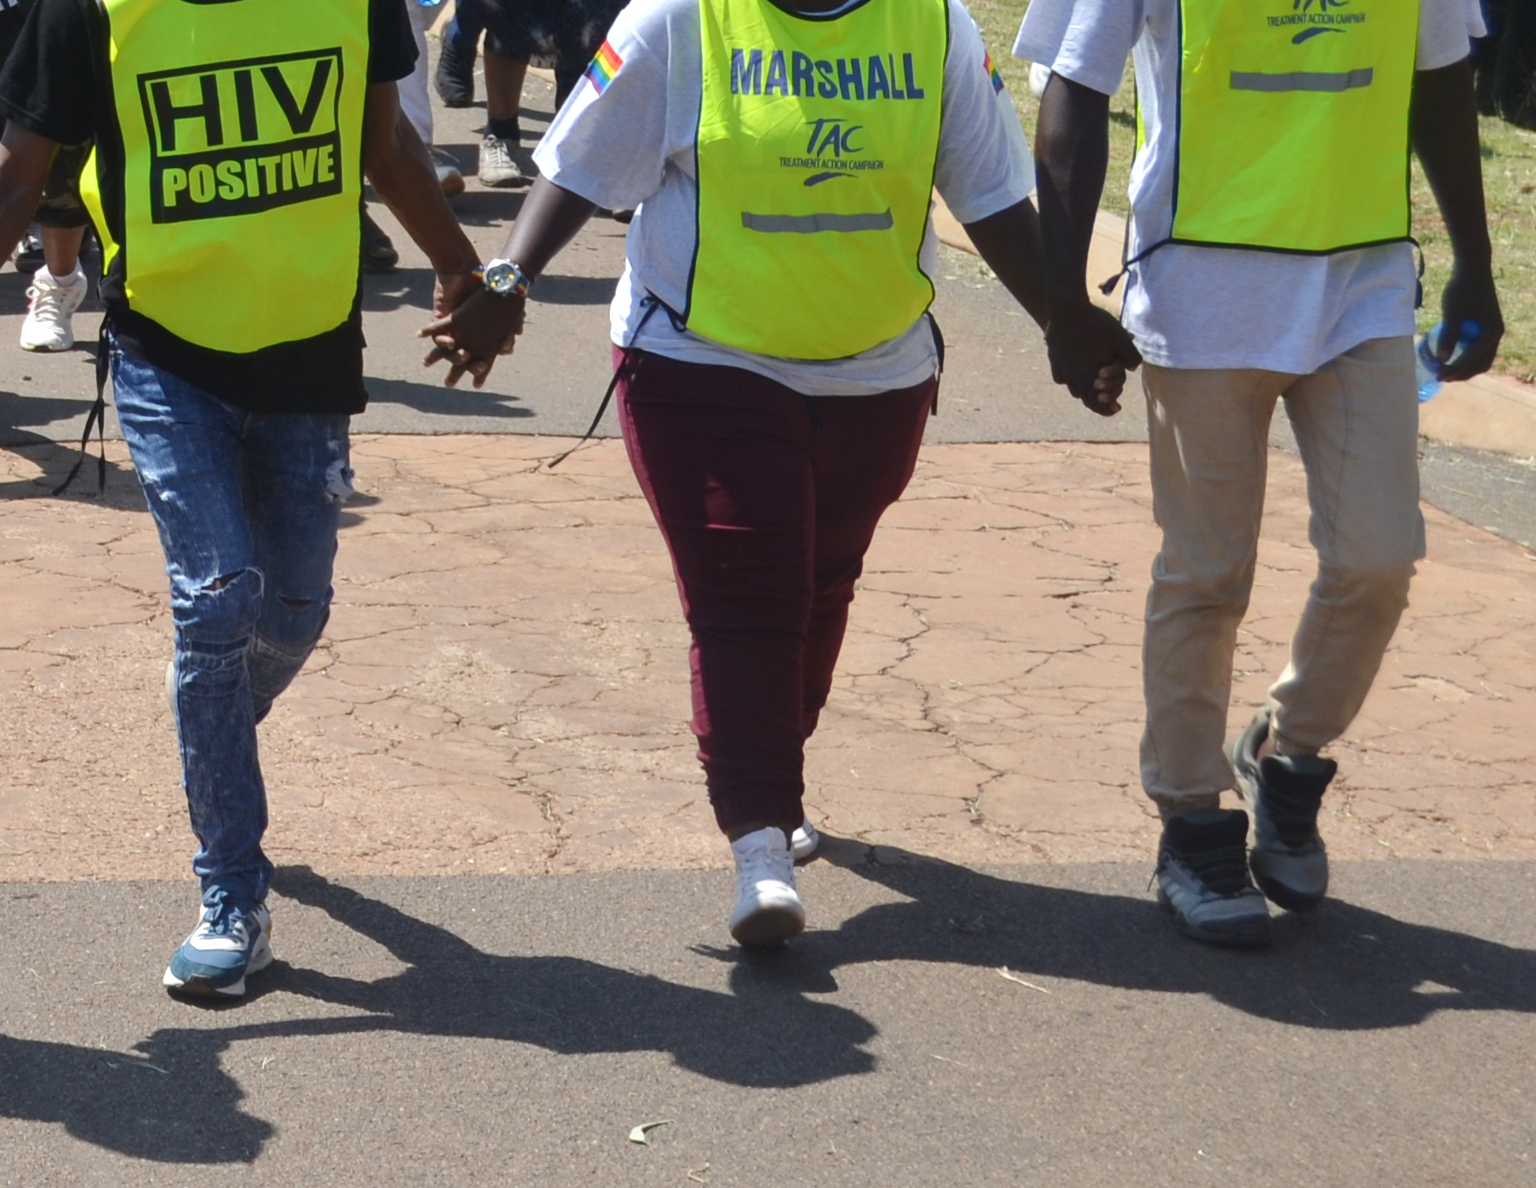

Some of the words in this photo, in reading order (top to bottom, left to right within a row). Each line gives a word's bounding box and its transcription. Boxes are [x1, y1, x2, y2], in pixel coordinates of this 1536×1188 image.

[1267, 15, 1307, 27] TREATMENT
[1307, 13, 1335, 25] ACTION
[730, 47, 924, 101] MARSHALL
[150, 58, 333, 152] HIV
[805, 118, 864, 158] TAC
[162, 143, 335, 208] POSITIVE
[779, 156, 821, 170] TREATMENT
[820, 158, 848, 170] ACTION
[848, 159, 885, 171] CAMPAIGN
